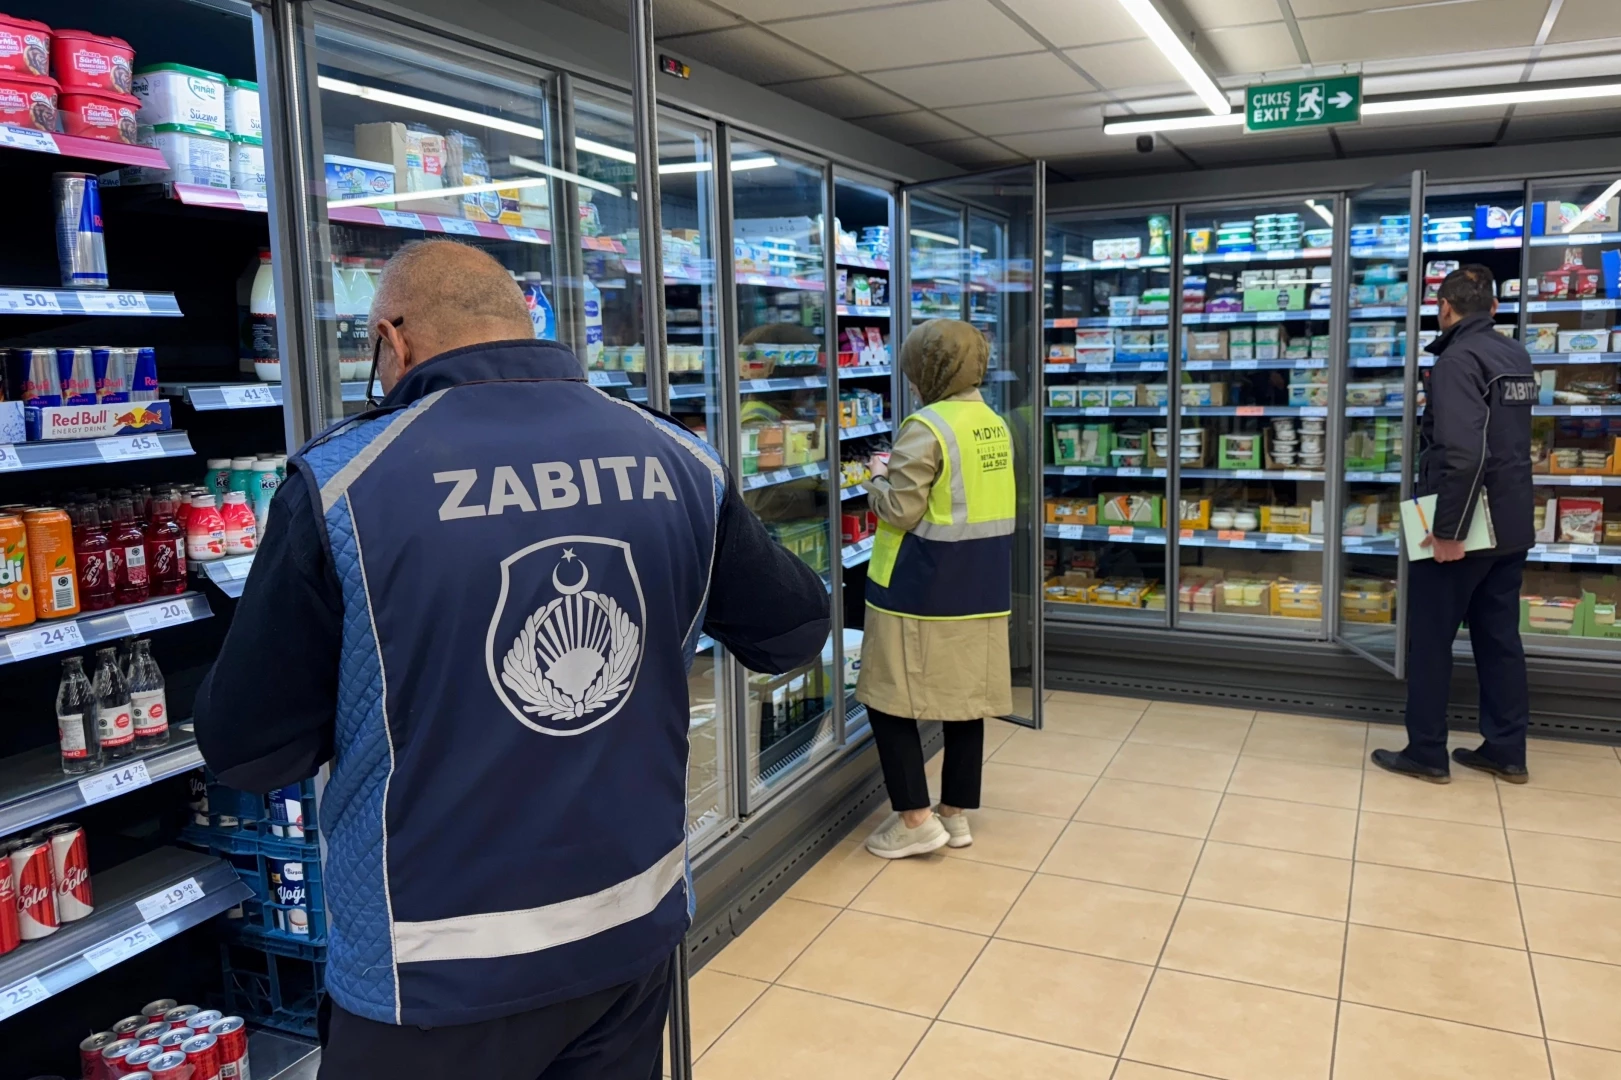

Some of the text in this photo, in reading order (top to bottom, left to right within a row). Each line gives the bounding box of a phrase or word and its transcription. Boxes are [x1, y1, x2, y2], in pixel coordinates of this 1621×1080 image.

[79, 56, 106, 65] SürMix
[193, 83, 216, 95] PINAR
[1252, 91, 1291, 109] ÇIKIŞ
[87, 109, 113, 118] SürMix
[189, 108, 218, 123] Süzme
[1253, 106, 1290, 123] EXIT
[23, 293, 47, 307] 50
[118, 295, 138, 306] 80
[69, 378, 90, 389] Bull
[103, 377, 124, 387] Bull
[52, 410, 107, 427] Red Bull
[52, 425, 107, 435] ENERGY DRINK
[131, 436, 151, 449] 45
[433, 456, 677, 522] ZABITA
[161, 604, 181, 619] 20
[41, 625, 76, 645] 24,50
[112, 765, 144, 787] 14,75
[59, 868, 88, 896] Cola
[16, 887, 49, 914] Cola
[165, 883, 193, 906] 19,50
[124, 930, 147, 948] 25
[6, 985, 33, 1004] 25
